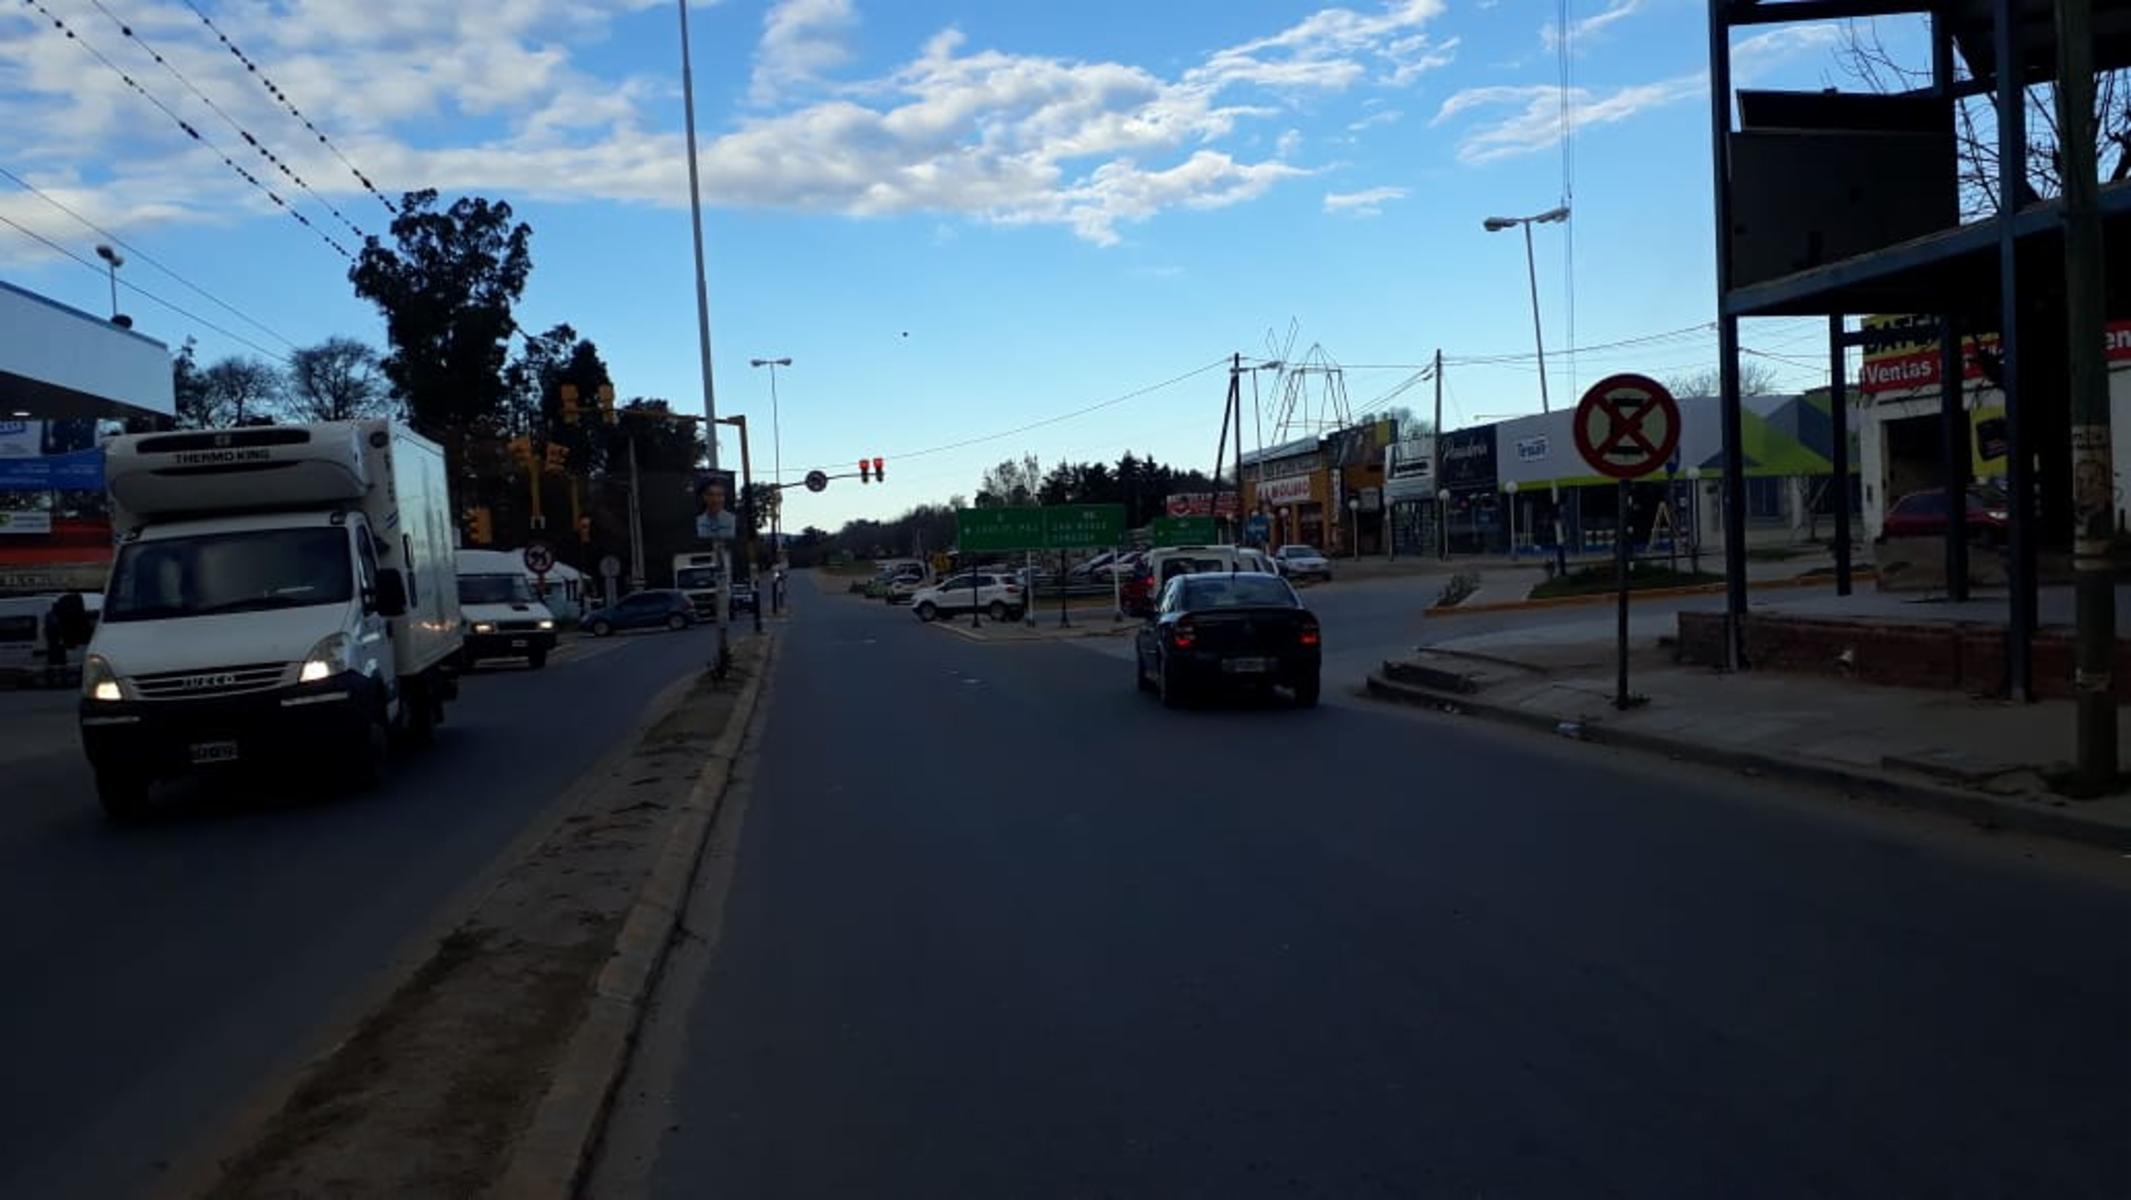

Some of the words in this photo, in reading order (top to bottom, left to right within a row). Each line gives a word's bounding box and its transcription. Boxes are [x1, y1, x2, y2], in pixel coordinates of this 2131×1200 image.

[1865, 359, 1932, 384] Ventas
[175, 451, 234, 465] THERMO
[237, 449, 270, 461] KING
